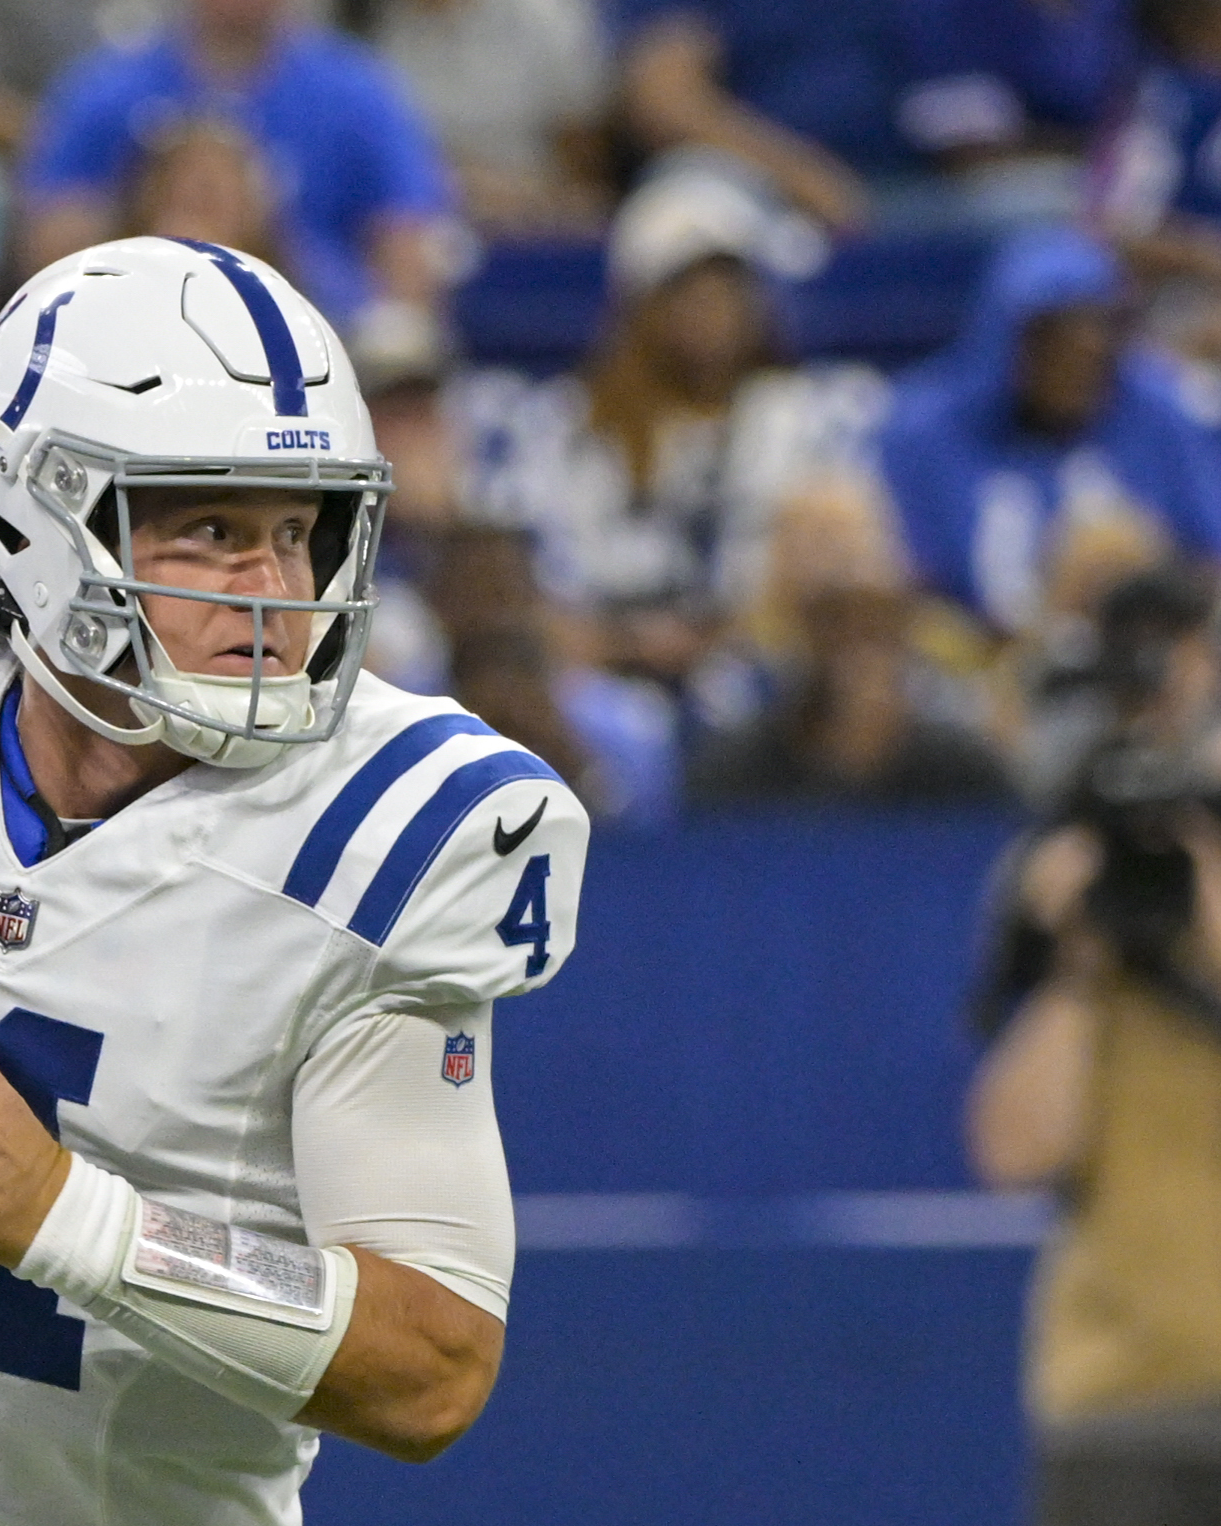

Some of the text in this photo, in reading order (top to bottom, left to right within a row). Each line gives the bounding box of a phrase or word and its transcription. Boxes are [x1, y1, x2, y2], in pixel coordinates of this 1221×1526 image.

[266, 430, 331, 451] COLTS
[495, 853, 551, 979] 4
[445, 1055, 473, 1081] NFL
